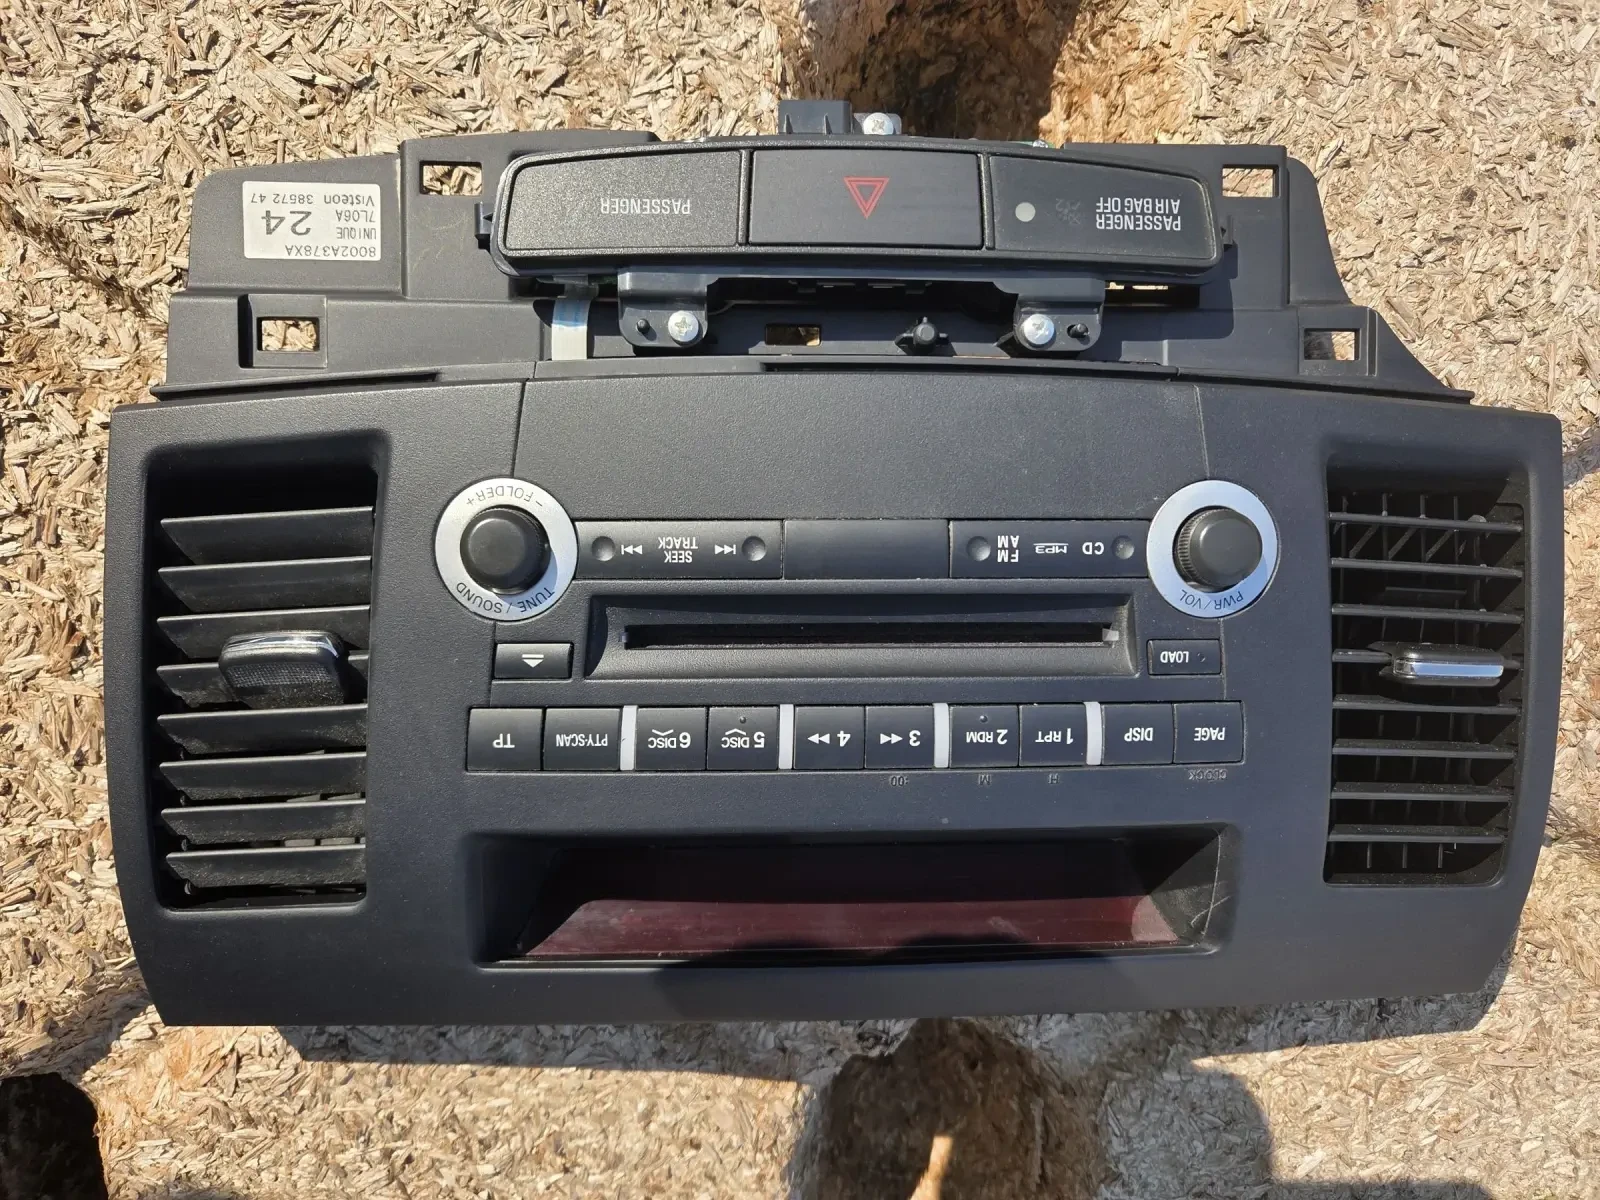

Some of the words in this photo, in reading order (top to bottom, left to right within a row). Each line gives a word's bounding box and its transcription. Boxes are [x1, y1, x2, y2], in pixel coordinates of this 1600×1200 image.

[250, 193, 267, 204] 47
[272, 193, 314, 205] 38572
[323, 194, 375, 207] Visteon
[1096, 197, 1121, 213] OFF
[600, 197, 691, 215] PASSENGER
[335, 209, 376, 222] 7L06A
[1096, 214, 1181, 231] PASSENGER
[261, 210, 312, 236] 24
[336, 226, 377, 240] UNIQUE
[284, 244, 376, 258] 8002A378XA
[658, 536, 698, 550] TRACK
[997, 535, 1020, 549] AM
[1034, 544, 1068, 554] MP3
[1082, 542, 1105, 555] CD
[664, 550, 693, 563] SEEK
[997, 549, 1019, 563] FM
[456, 582, 503, 614] SOUND
[517, 587, 556, 613] TUNE
[1160, 650, 1190, 663] LOAD
[492, 733, 515, 749] TP
[679, 731, 691, 749] 6
[753, 731, 765, 748] 5
[837, 730, 851, 747] 4
[909, 730, 921, 747] 3
[966, 731, 994, 743] RDM
[996, 729, 1008, 745] 2
[1035, 731, 1062, 743] RPT
[1066, 728, 1074, 745] 1
[1124, 727, 1154, 742] DISP
[1193, 727, 1226, 741] PAGE
[648, 737, 677, 749] DISC
[721, 736, 750, 748] DISC
[978, 773, 992, 786] M
